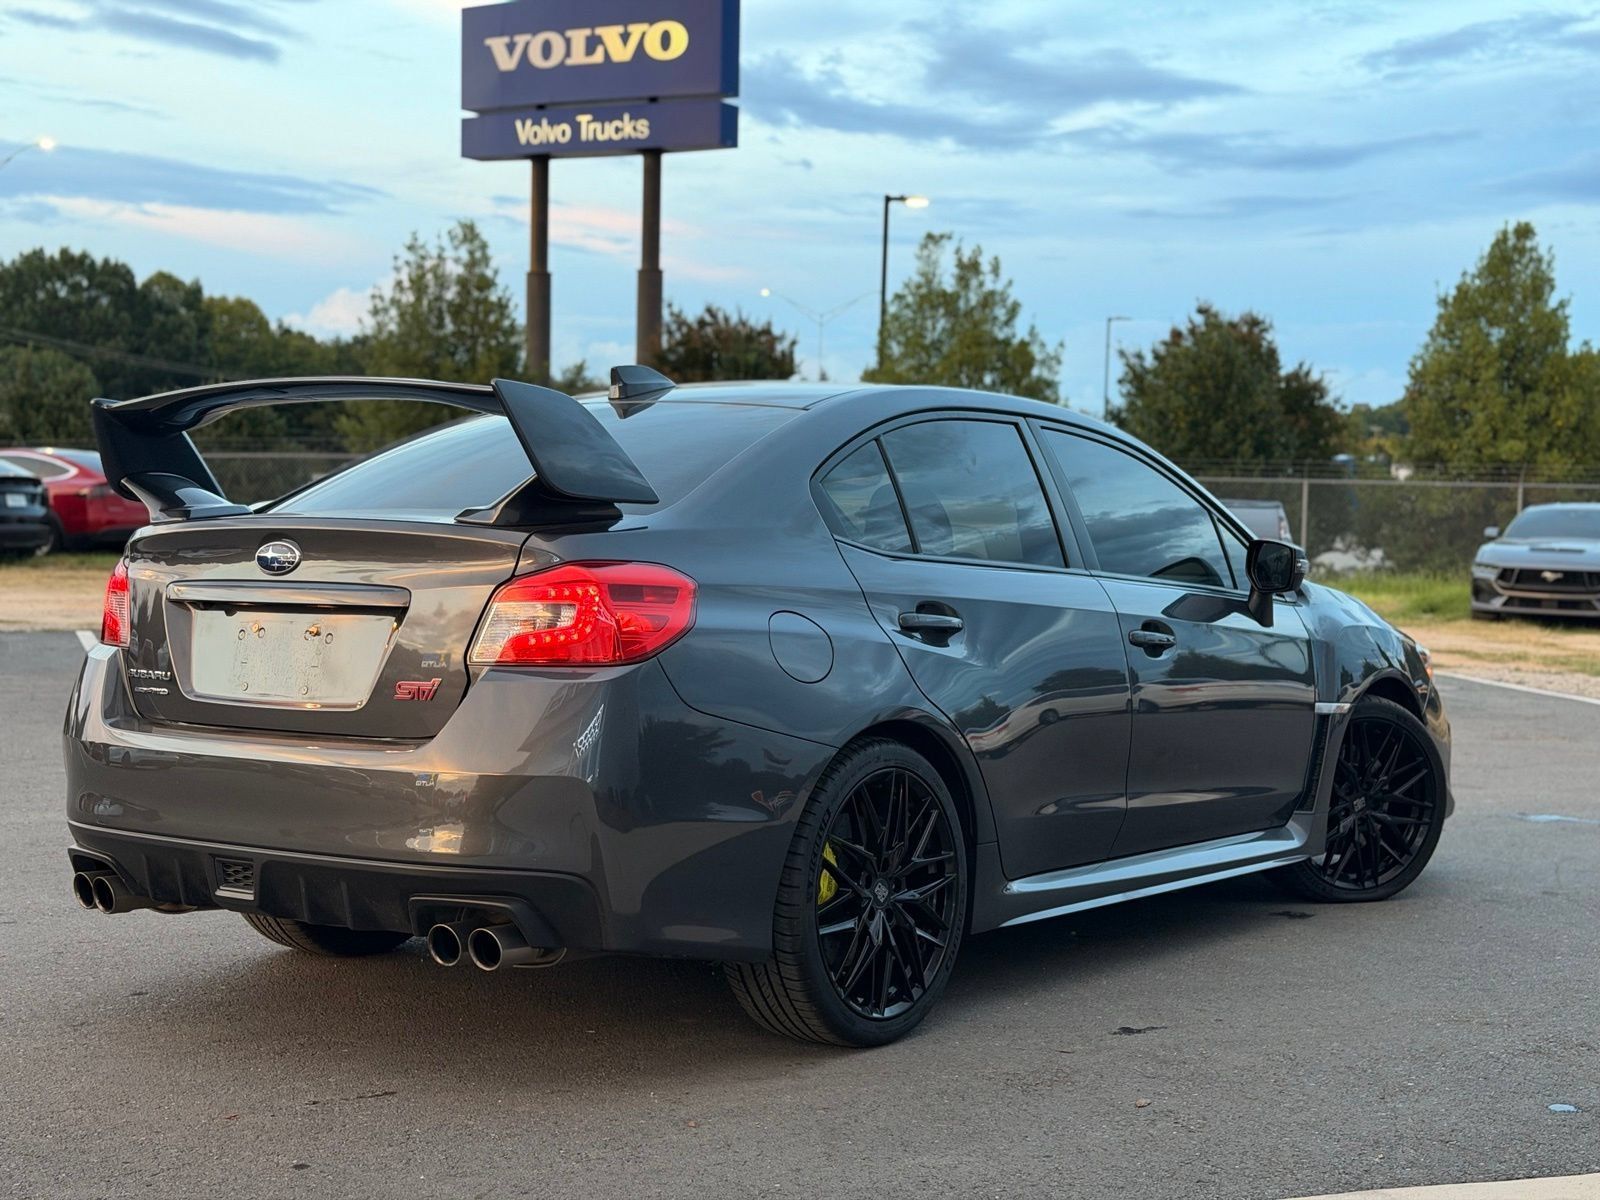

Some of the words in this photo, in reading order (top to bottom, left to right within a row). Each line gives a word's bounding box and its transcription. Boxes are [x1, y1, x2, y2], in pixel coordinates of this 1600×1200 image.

[484, 20, 689, 72] VOLVO
[515, 117, 571, 145] Volvo
[576, 113, 650, 142] Trucks
[128, 668, 171, 681] SUBARU
